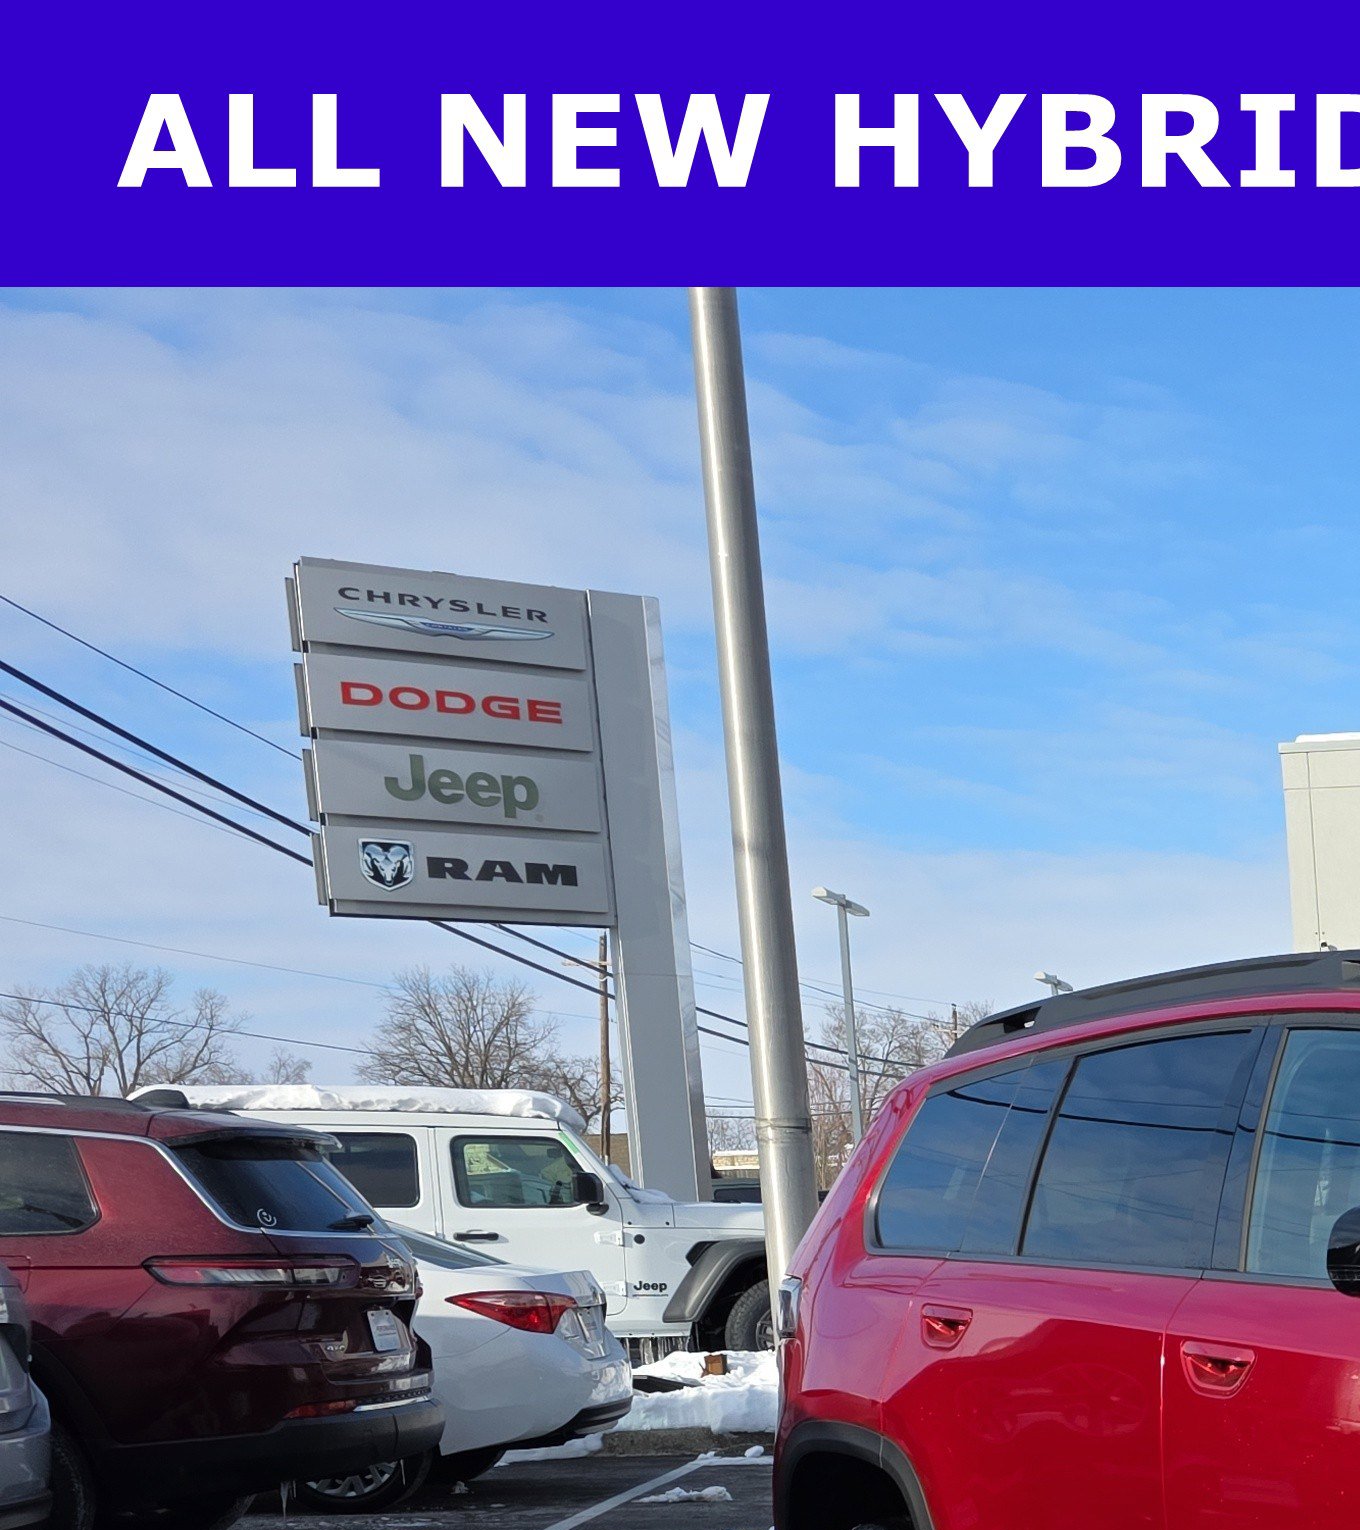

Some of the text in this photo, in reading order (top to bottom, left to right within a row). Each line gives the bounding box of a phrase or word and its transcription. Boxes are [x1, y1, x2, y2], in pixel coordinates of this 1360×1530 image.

[338, 586, 548, 623] CHRYSLER
[340, 681, 562, 724] DODGE
[384, 754, 540, 819] Jeep
[426, 856, 578, 887] RAM
[633, 1280, 668, 1292] Jeep
